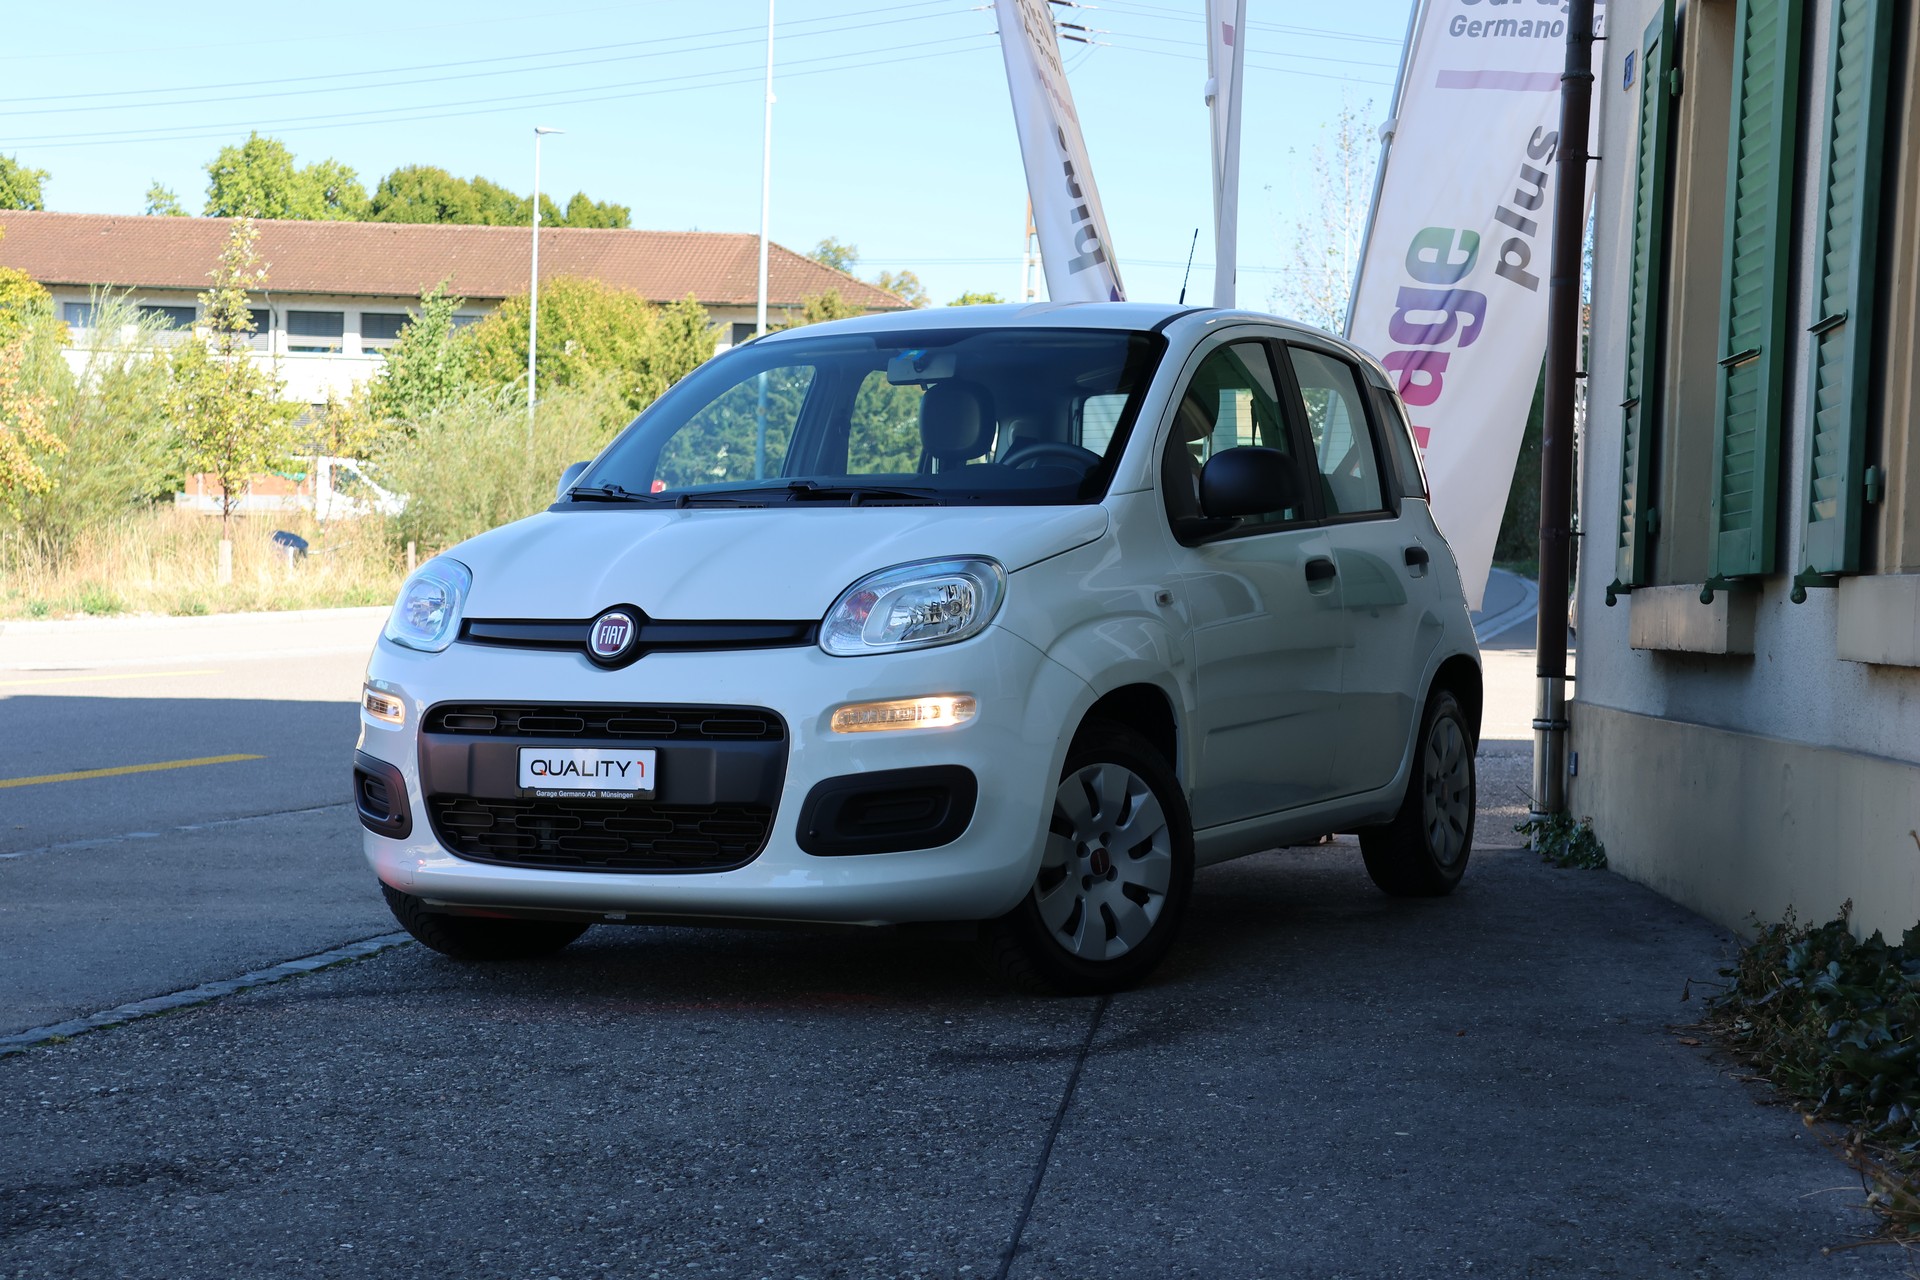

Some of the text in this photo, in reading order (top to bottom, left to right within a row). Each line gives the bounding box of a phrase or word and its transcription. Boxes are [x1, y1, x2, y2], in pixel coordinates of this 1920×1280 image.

[1449, 14, 1565, 39] Germano
[1494, 125, 1559, 292] plus
[1381, 226, 1488, 463] age
[599, 625, 626, 645] FIAT
[530, 759, 645, 778] QUALITY 1
[536, 790, 557, 798] Garage
[558, 790, 586, 798] Germano
[600, 791, 634, 799] Münsingen
